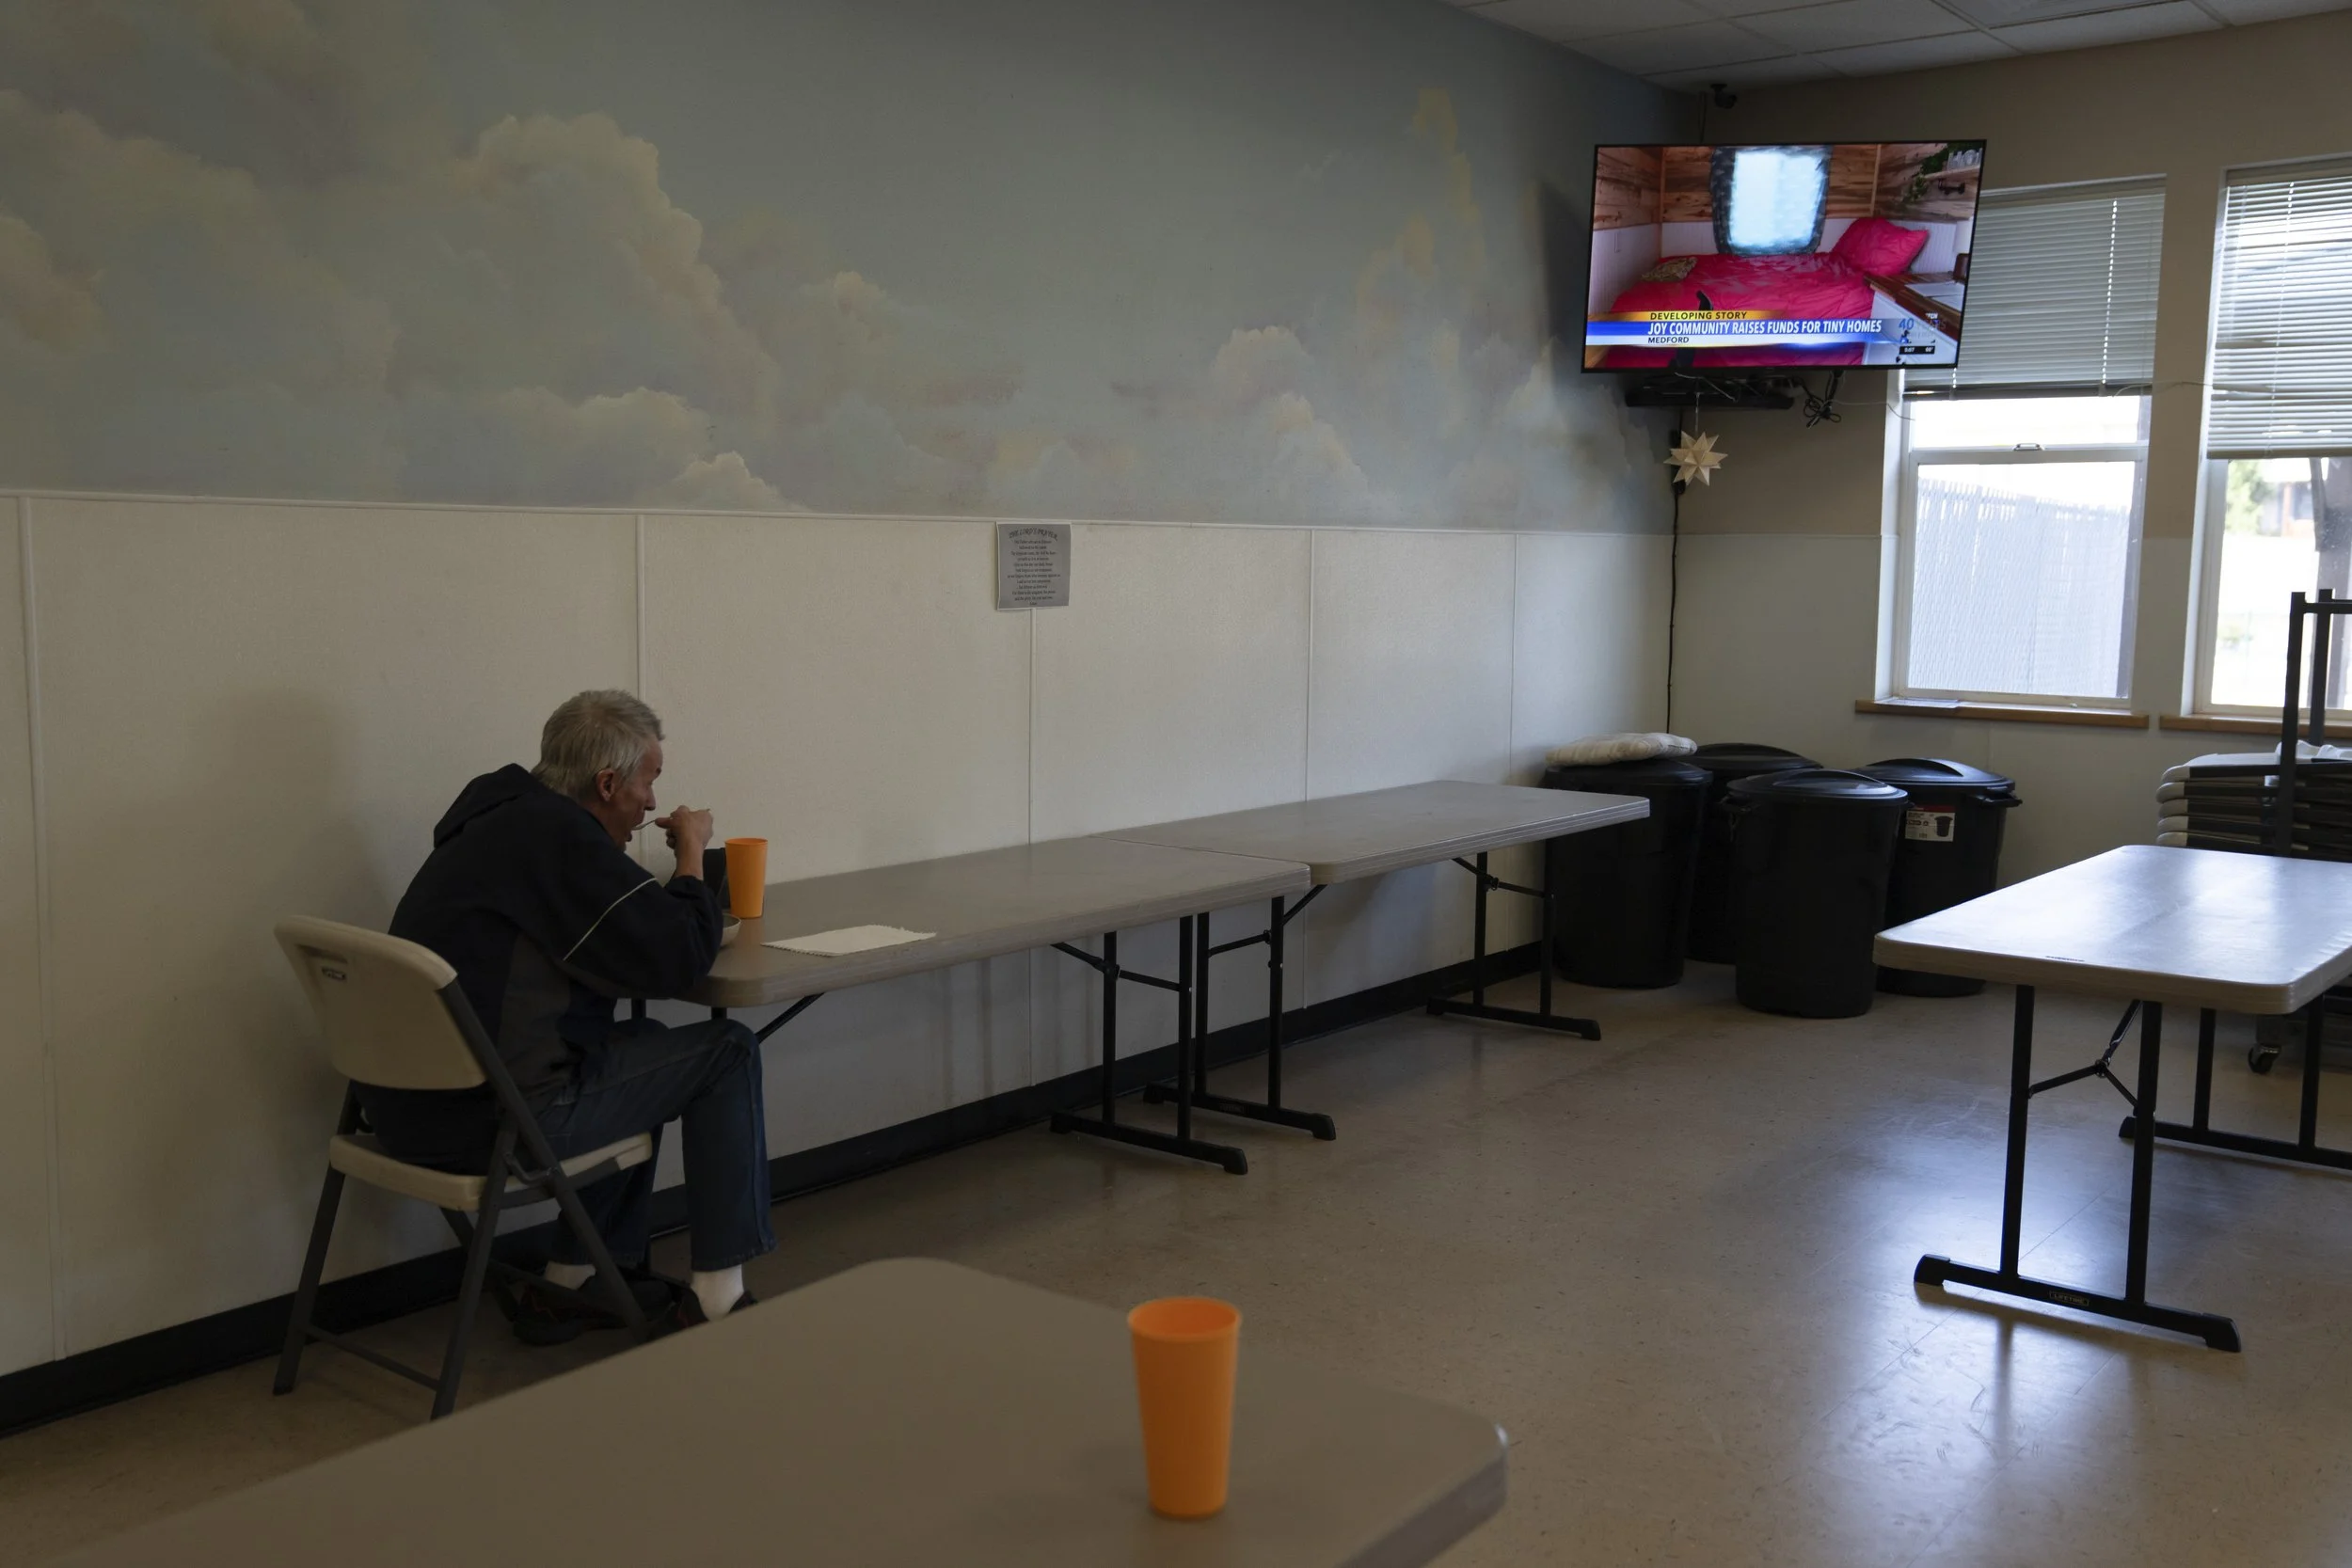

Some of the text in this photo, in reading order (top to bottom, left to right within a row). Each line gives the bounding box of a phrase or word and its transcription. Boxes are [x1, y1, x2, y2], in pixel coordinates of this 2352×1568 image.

[1650, 311, 1712, 320] DEVELOPING
[1648, 320, 1882, 335] JOY COMMUNITY RAISES FUNDS FOR TINY HOMES
[1899, 318, 1915, 330] 40
